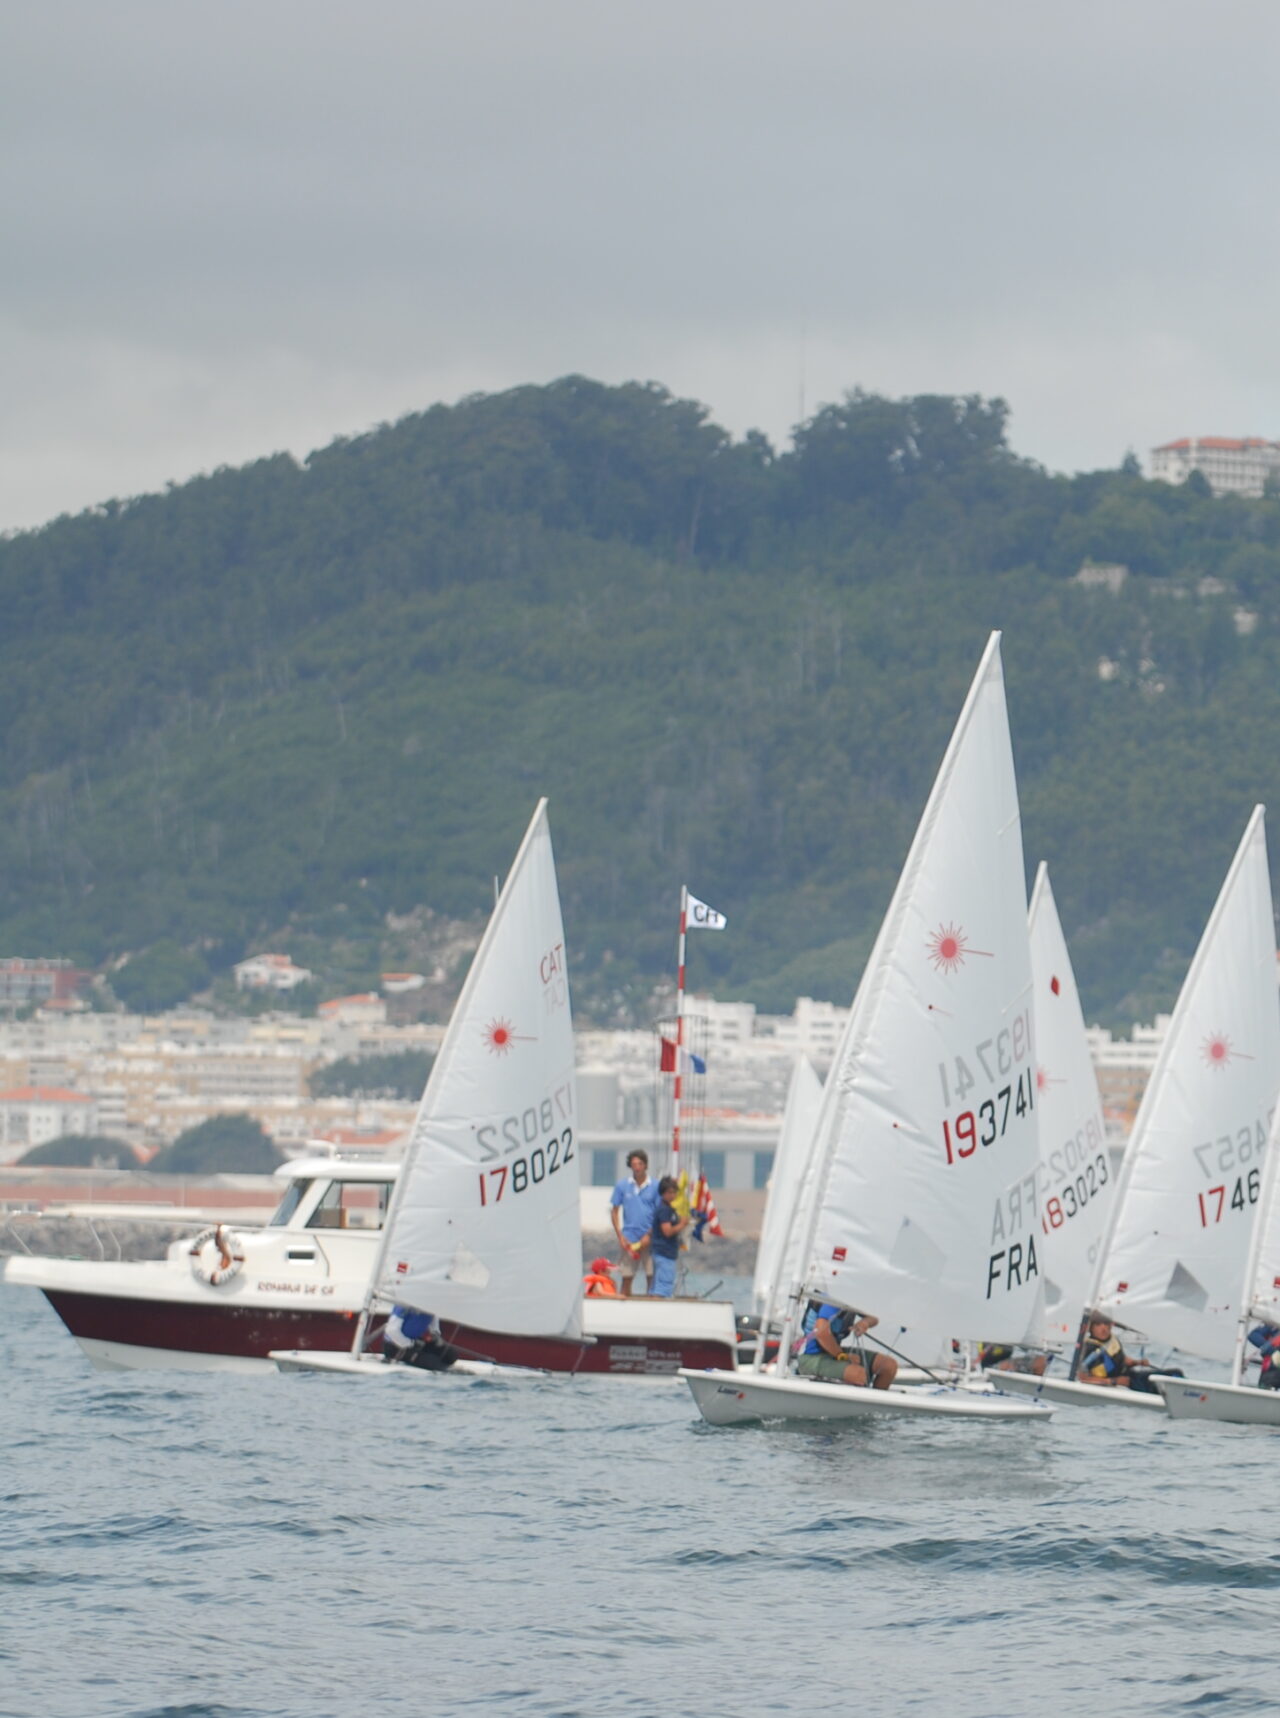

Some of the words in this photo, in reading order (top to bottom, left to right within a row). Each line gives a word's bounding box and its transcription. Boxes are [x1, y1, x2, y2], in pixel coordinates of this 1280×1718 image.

[540, 943, 563, 985] CAT
[942, 1067, 1034, 1165] 193741
[479, 1127, 574, 1207] 178022
[1041, 1155, 1108, 1234] 183023
[986, 1234, 1038, 1299] FRA
